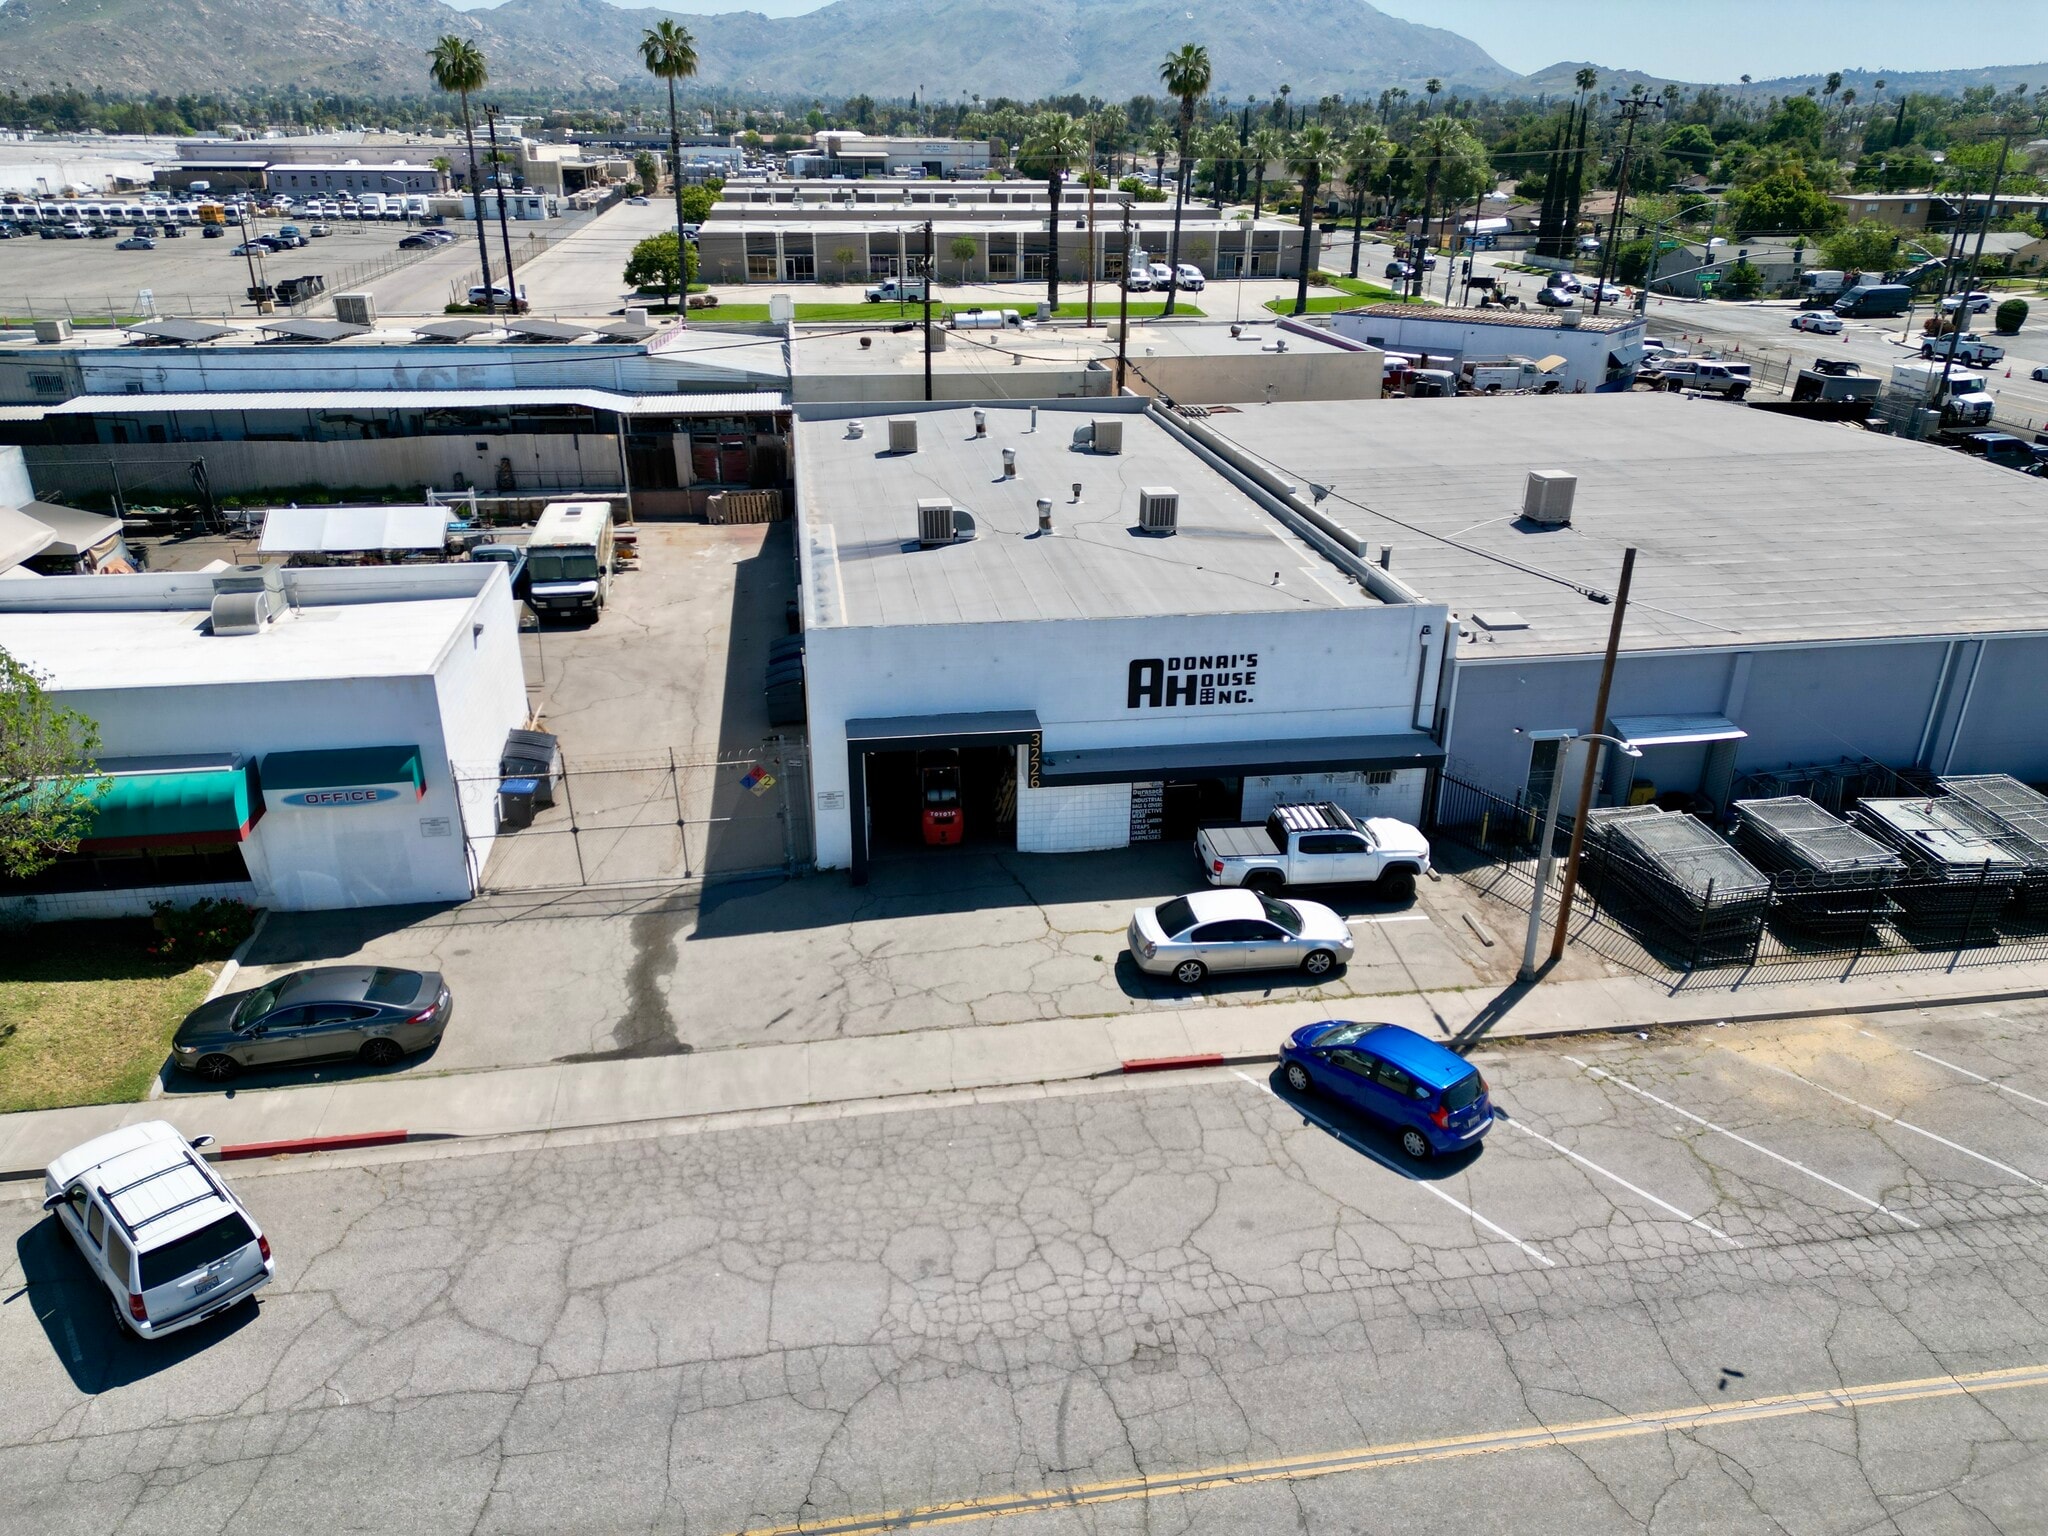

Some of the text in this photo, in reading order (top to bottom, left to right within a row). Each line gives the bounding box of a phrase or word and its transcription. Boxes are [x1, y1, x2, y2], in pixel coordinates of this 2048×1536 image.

[1031, 733, 1041, 789] 3226
[763, 775, 772, 786] 2
[305, 790, 377, 804] OFFICE
